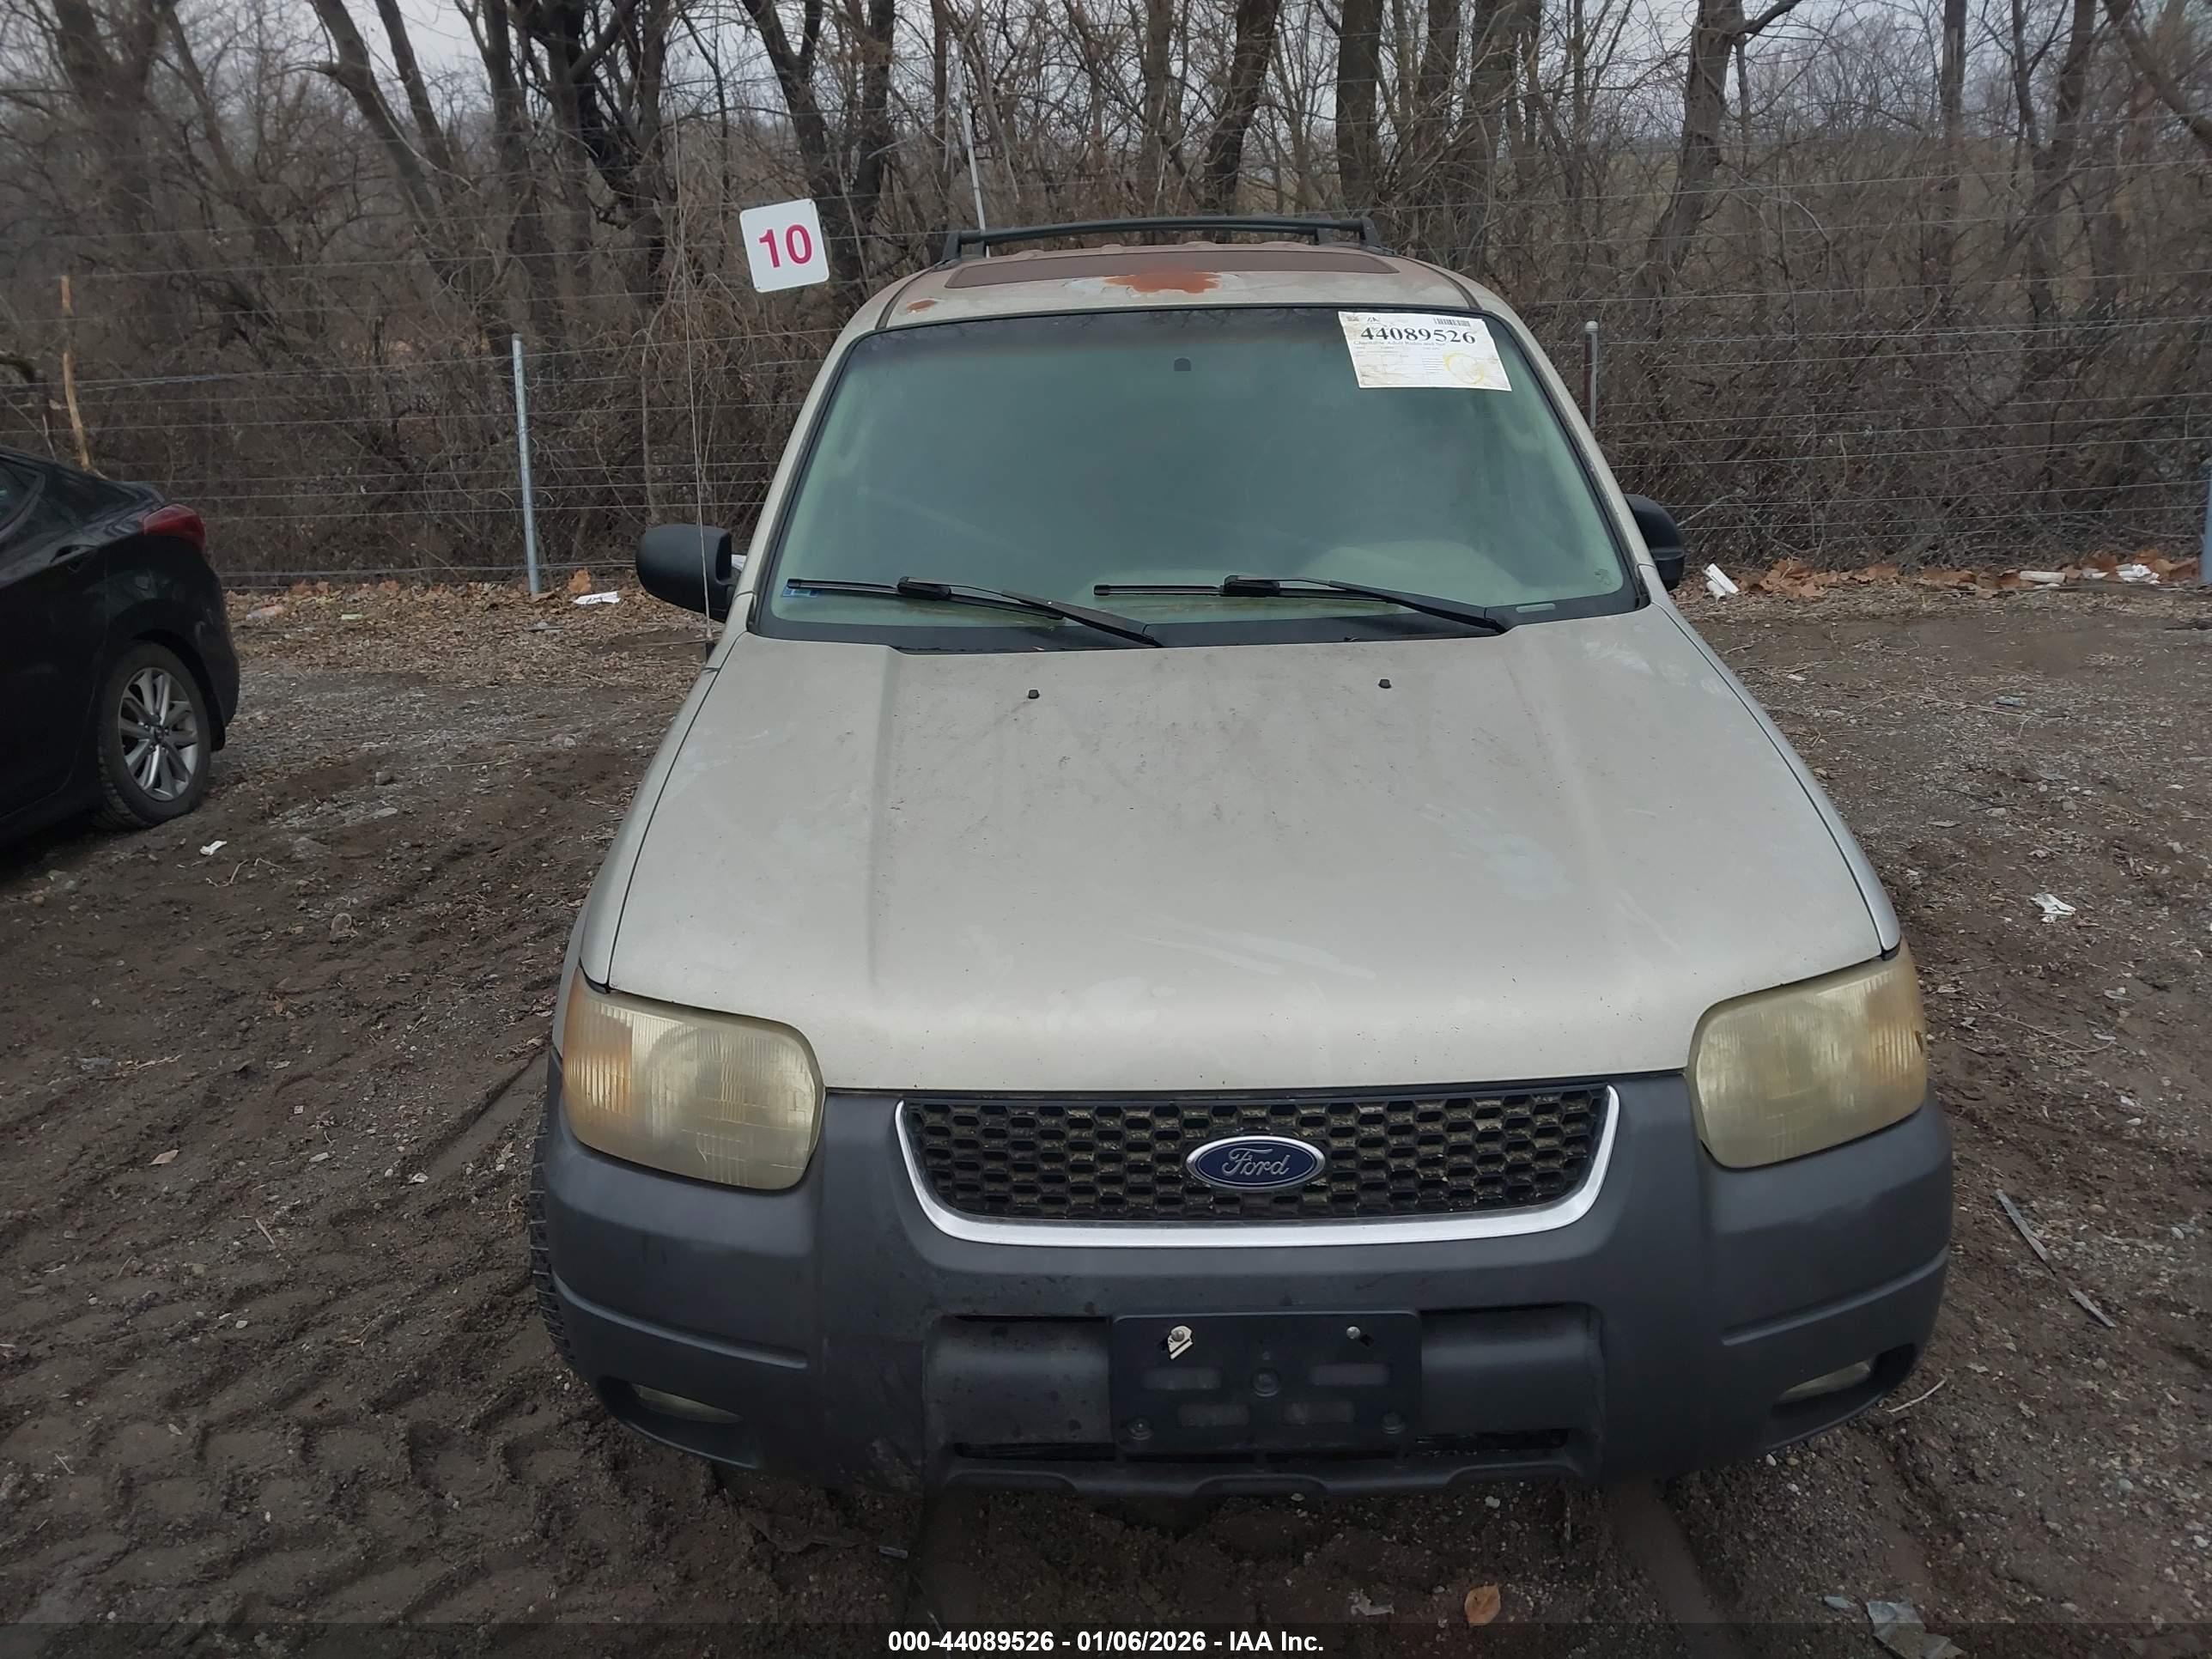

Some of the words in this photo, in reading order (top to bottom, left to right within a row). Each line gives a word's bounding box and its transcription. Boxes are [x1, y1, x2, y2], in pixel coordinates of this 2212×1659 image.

[758, 224, 812, 268] 10
[1360, 326, 1476, 344] 44089526
[1221, 1147, 1291, 1176] Ford
